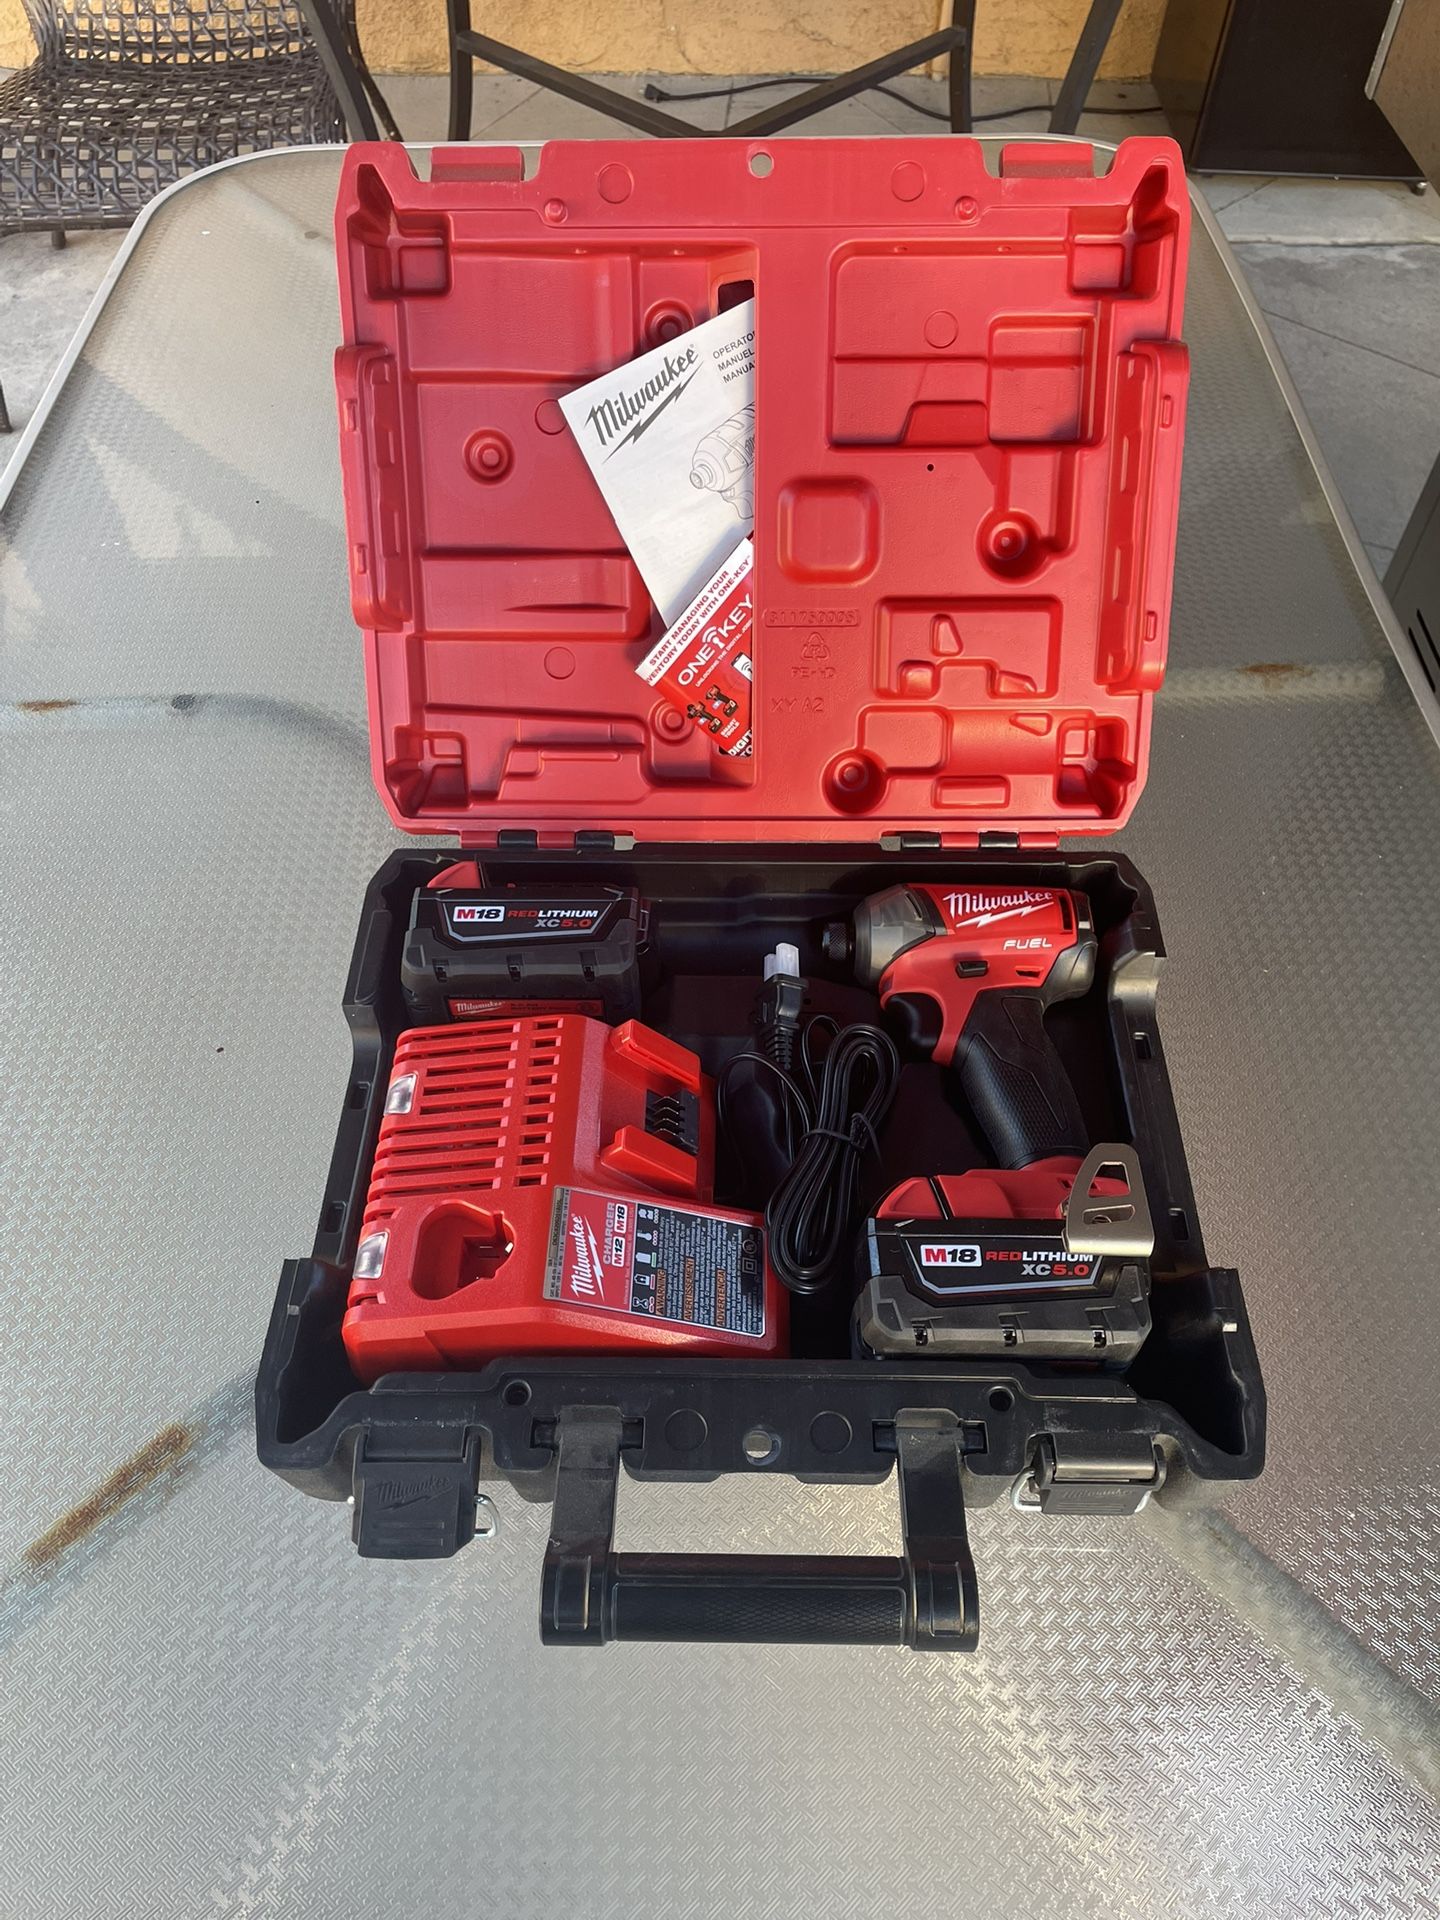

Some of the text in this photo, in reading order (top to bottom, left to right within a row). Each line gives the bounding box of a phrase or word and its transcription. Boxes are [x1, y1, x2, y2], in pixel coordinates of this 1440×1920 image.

[713, 331, 755, 359] OPERATO
[718, 348, 755, 371] MANUEL
[723, 361, 755, 383] MANUA
[584, 347, 699, 446] Milwaukee
[649, 570, 729, 666] START MANAGING YOUR
[678, 619, 701, 646] TODAY
[700, 597, 719, 618] WITH
[770, 696, 825, 713] XY A2
[456, 908, 599, 920] M18 REDLITHIUM
[943, 891, 1053, 919] Milwaukee
[1003, 938, 1053, 951] FUEL
[455, 1001, 505, 1012] Milwaukee
[603, 1202, 615, 1264] CHARGER
[614, 1205, 626, 1265] M12 M18
[569, 1216, 597, 1298] Milwaukee
[924, 1248, 1094, 1263] M18 REDLITHIUM
[1021, 1264, 1089, 1276] XC5.0
[656, 1269, 664, 1306] WARNING
[684, 1258, 693, 1319] AVERTISSEMENT
[716, 1270, 725, 1325] ADVERTENCIA
